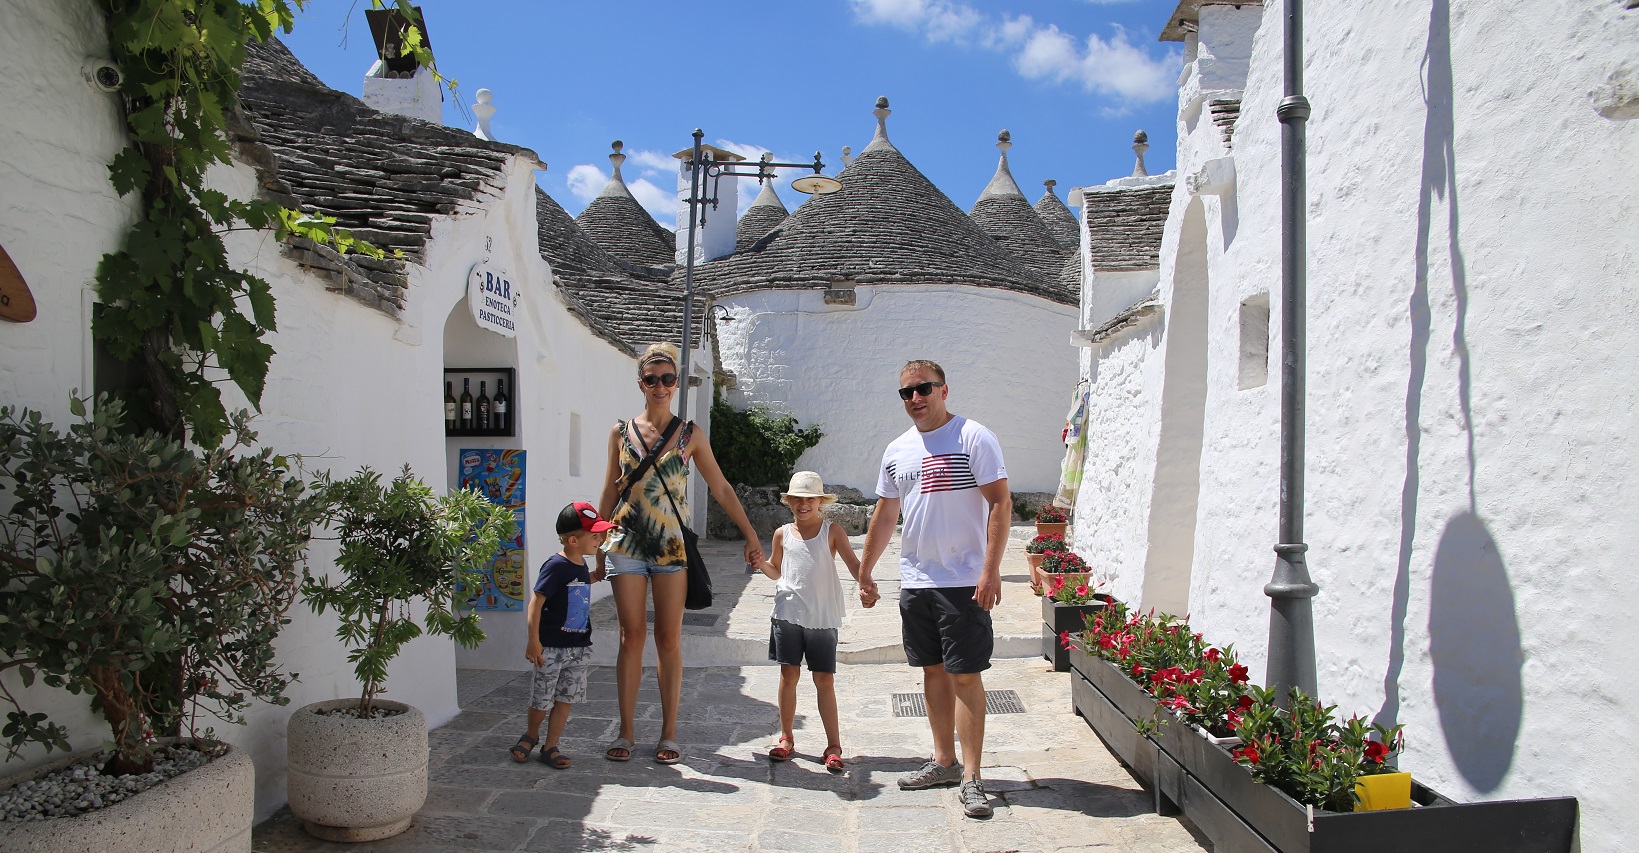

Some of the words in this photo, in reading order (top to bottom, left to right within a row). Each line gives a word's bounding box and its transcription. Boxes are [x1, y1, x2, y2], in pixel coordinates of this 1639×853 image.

[485, 271, 511, 301] BAR
[485, 296, 511, 316] ENOTECA
[479, 308, 515, 331] PASTICCERIA
[898, 467, 946, 482] HILFIGER
